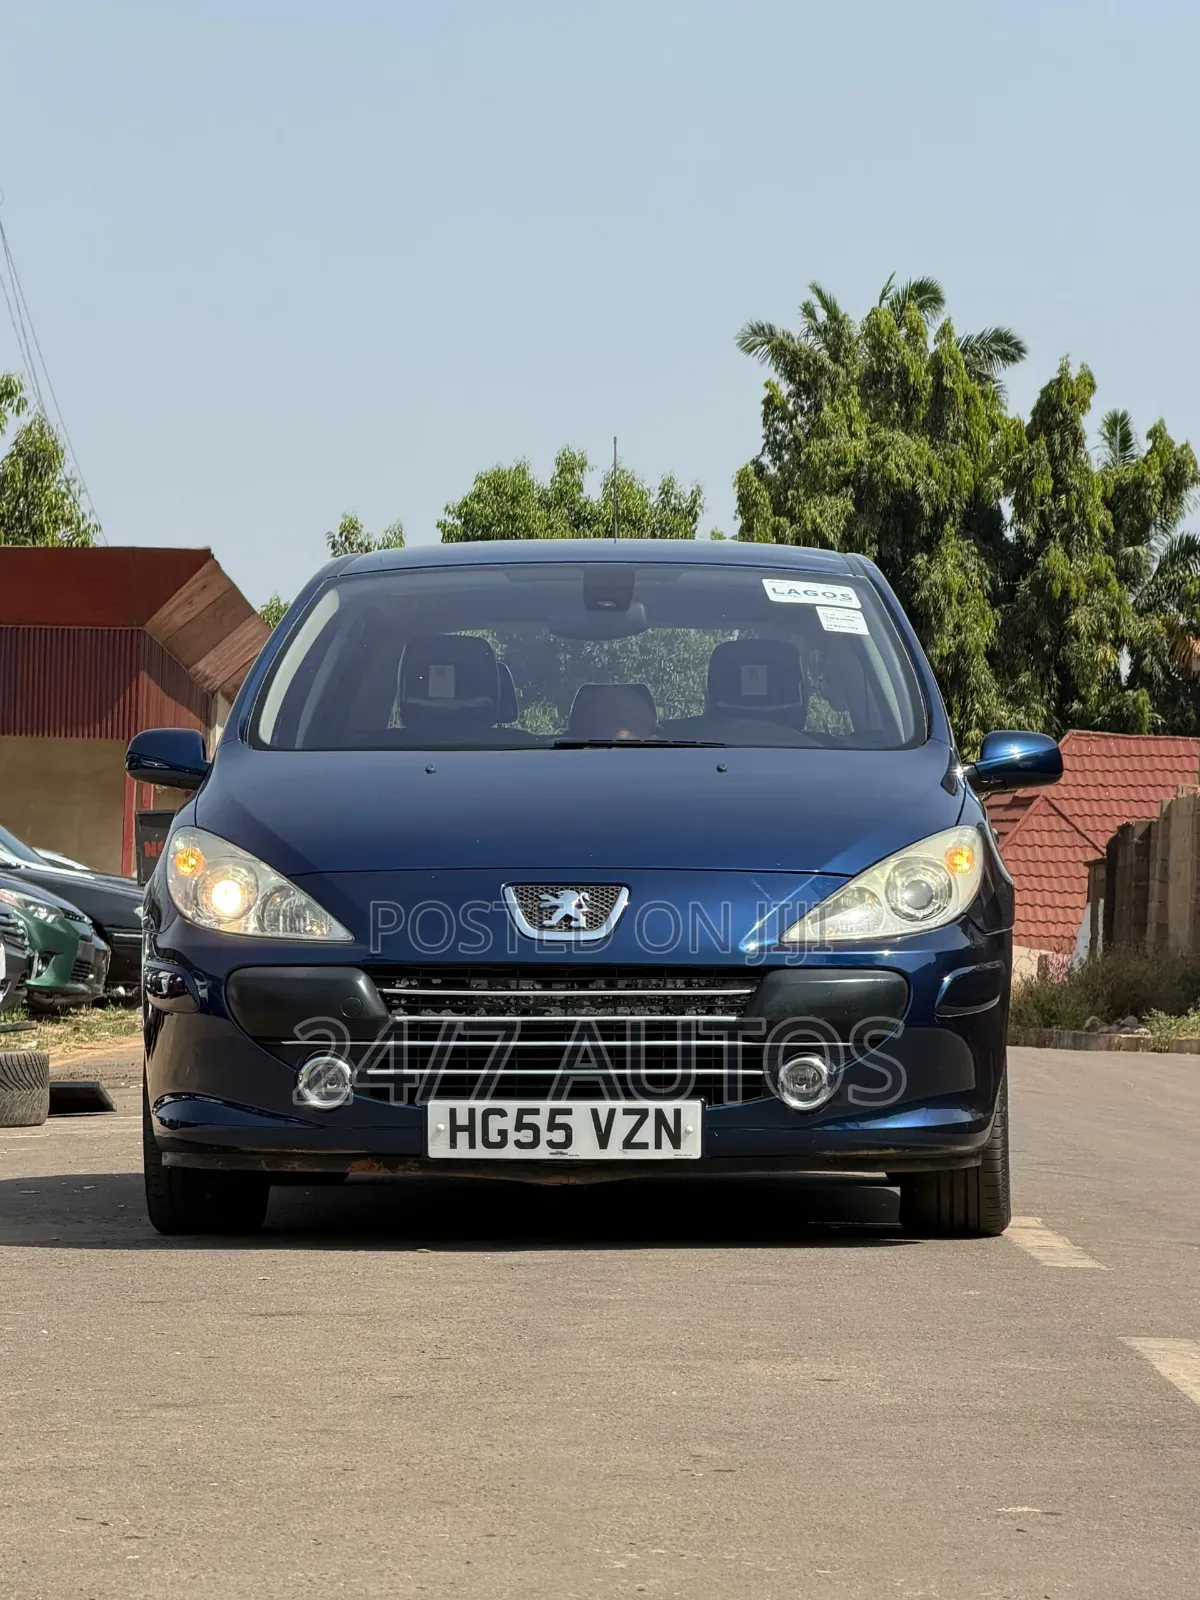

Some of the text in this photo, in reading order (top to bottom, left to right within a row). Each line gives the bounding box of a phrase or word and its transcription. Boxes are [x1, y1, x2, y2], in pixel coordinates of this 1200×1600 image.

[771, 587, 853, 601] LAGOS
[449, 1107, 682, 1150] HG55 VZN
